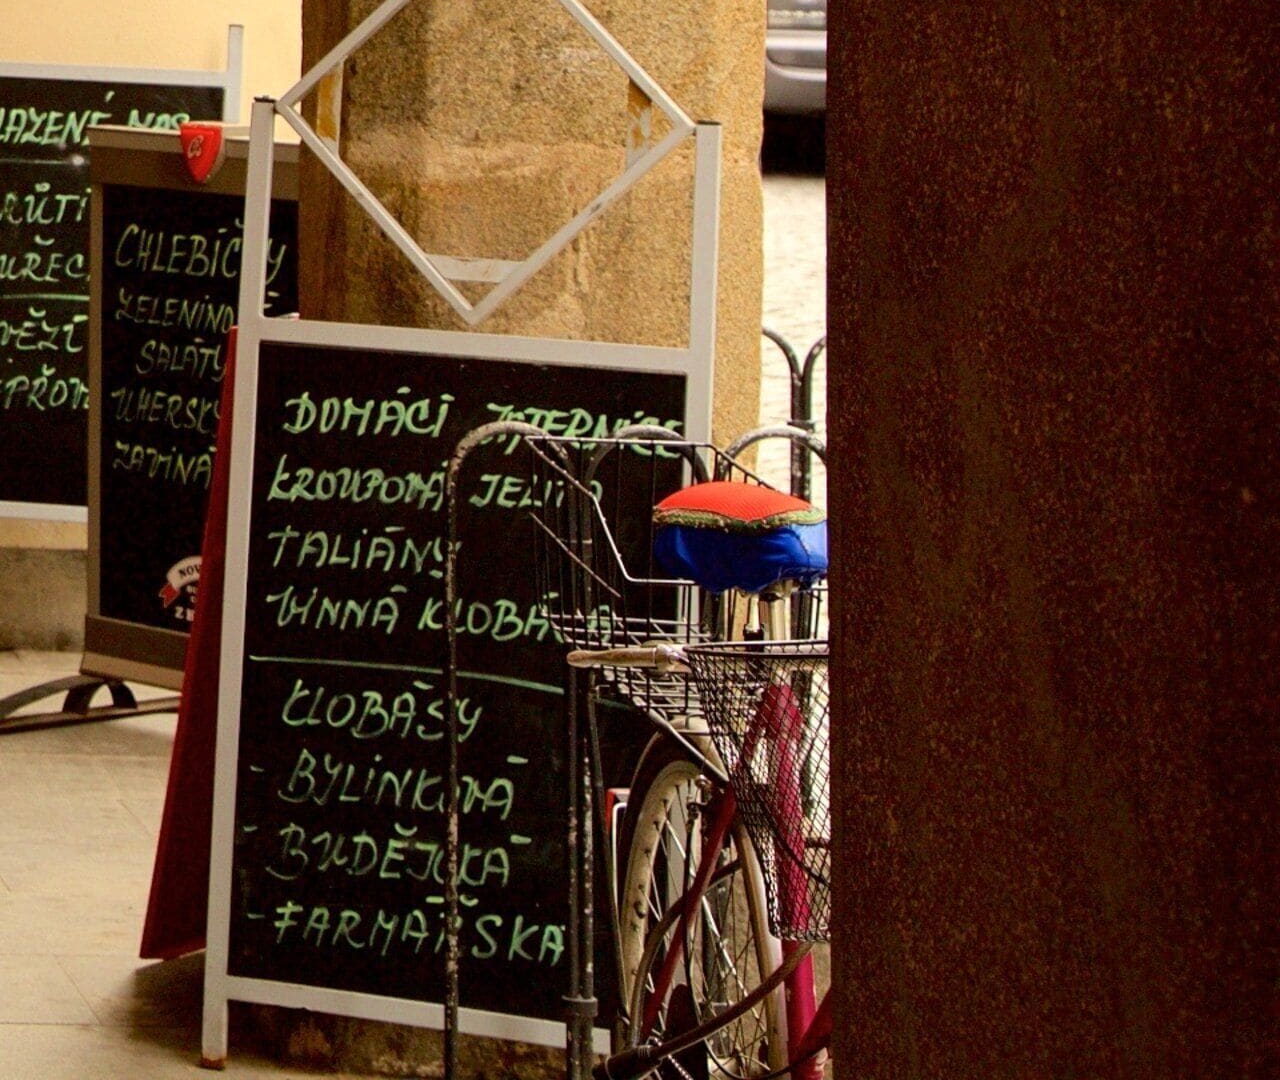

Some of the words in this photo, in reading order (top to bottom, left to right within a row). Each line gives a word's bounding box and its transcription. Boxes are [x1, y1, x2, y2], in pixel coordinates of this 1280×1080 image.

[115, 218, 287, 286] CHLEBÍČY
[281, 386, 456, 438] DOMÁCÍ
[281, 679, 483, 743] KLOBÁSY
